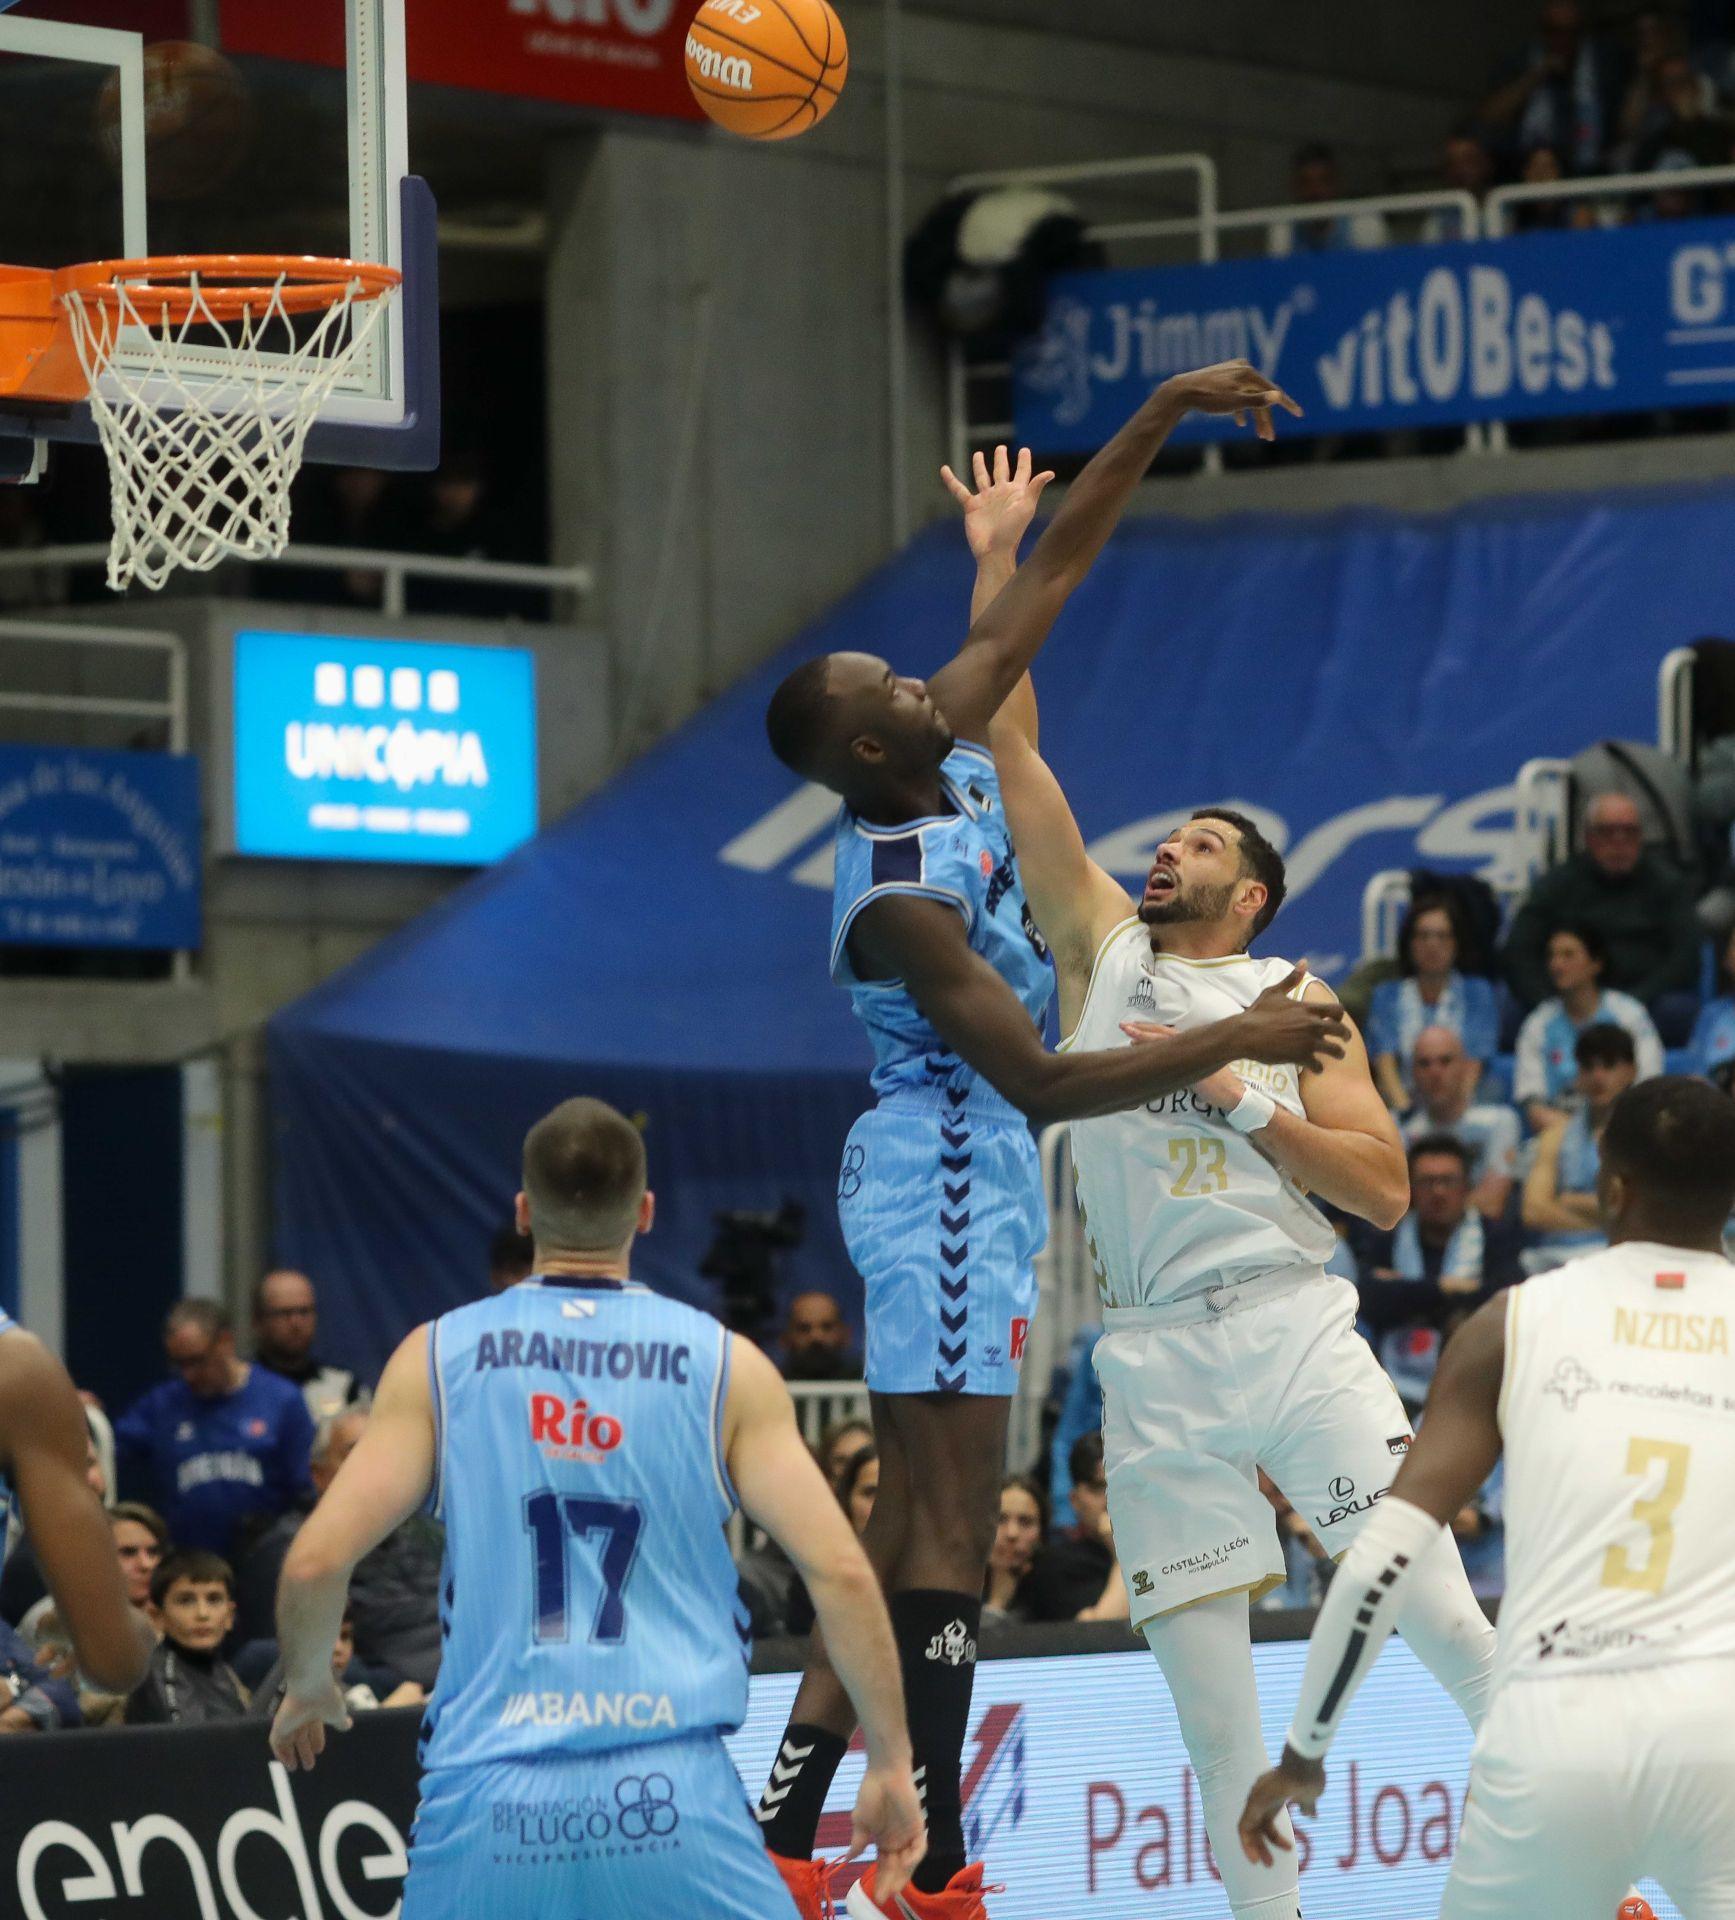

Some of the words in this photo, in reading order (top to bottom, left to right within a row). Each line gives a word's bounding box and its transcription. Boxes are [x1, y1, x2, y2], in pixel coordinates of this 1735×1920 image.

[685, 32, 753, 91] Wilson
[1093, 301, 1293, 381] Jimmy
[1168, 1138, 1228, 1197] 23
[475, 1329, 690, 1385] ARANITOVIC
[1612, 1305, 1728, 1356] NZOSA
[1601, 1437, 1690, 1597] 3
[521, 1487, 648, 1646] 17
[1161, 1552, 1210, 1575] CASTILLA
[1213, 1546, 1220, 1558] Y
[1223, 1536, 1250, 1553] LEÓN
[520, 1811, 612, 1846] LUGO
